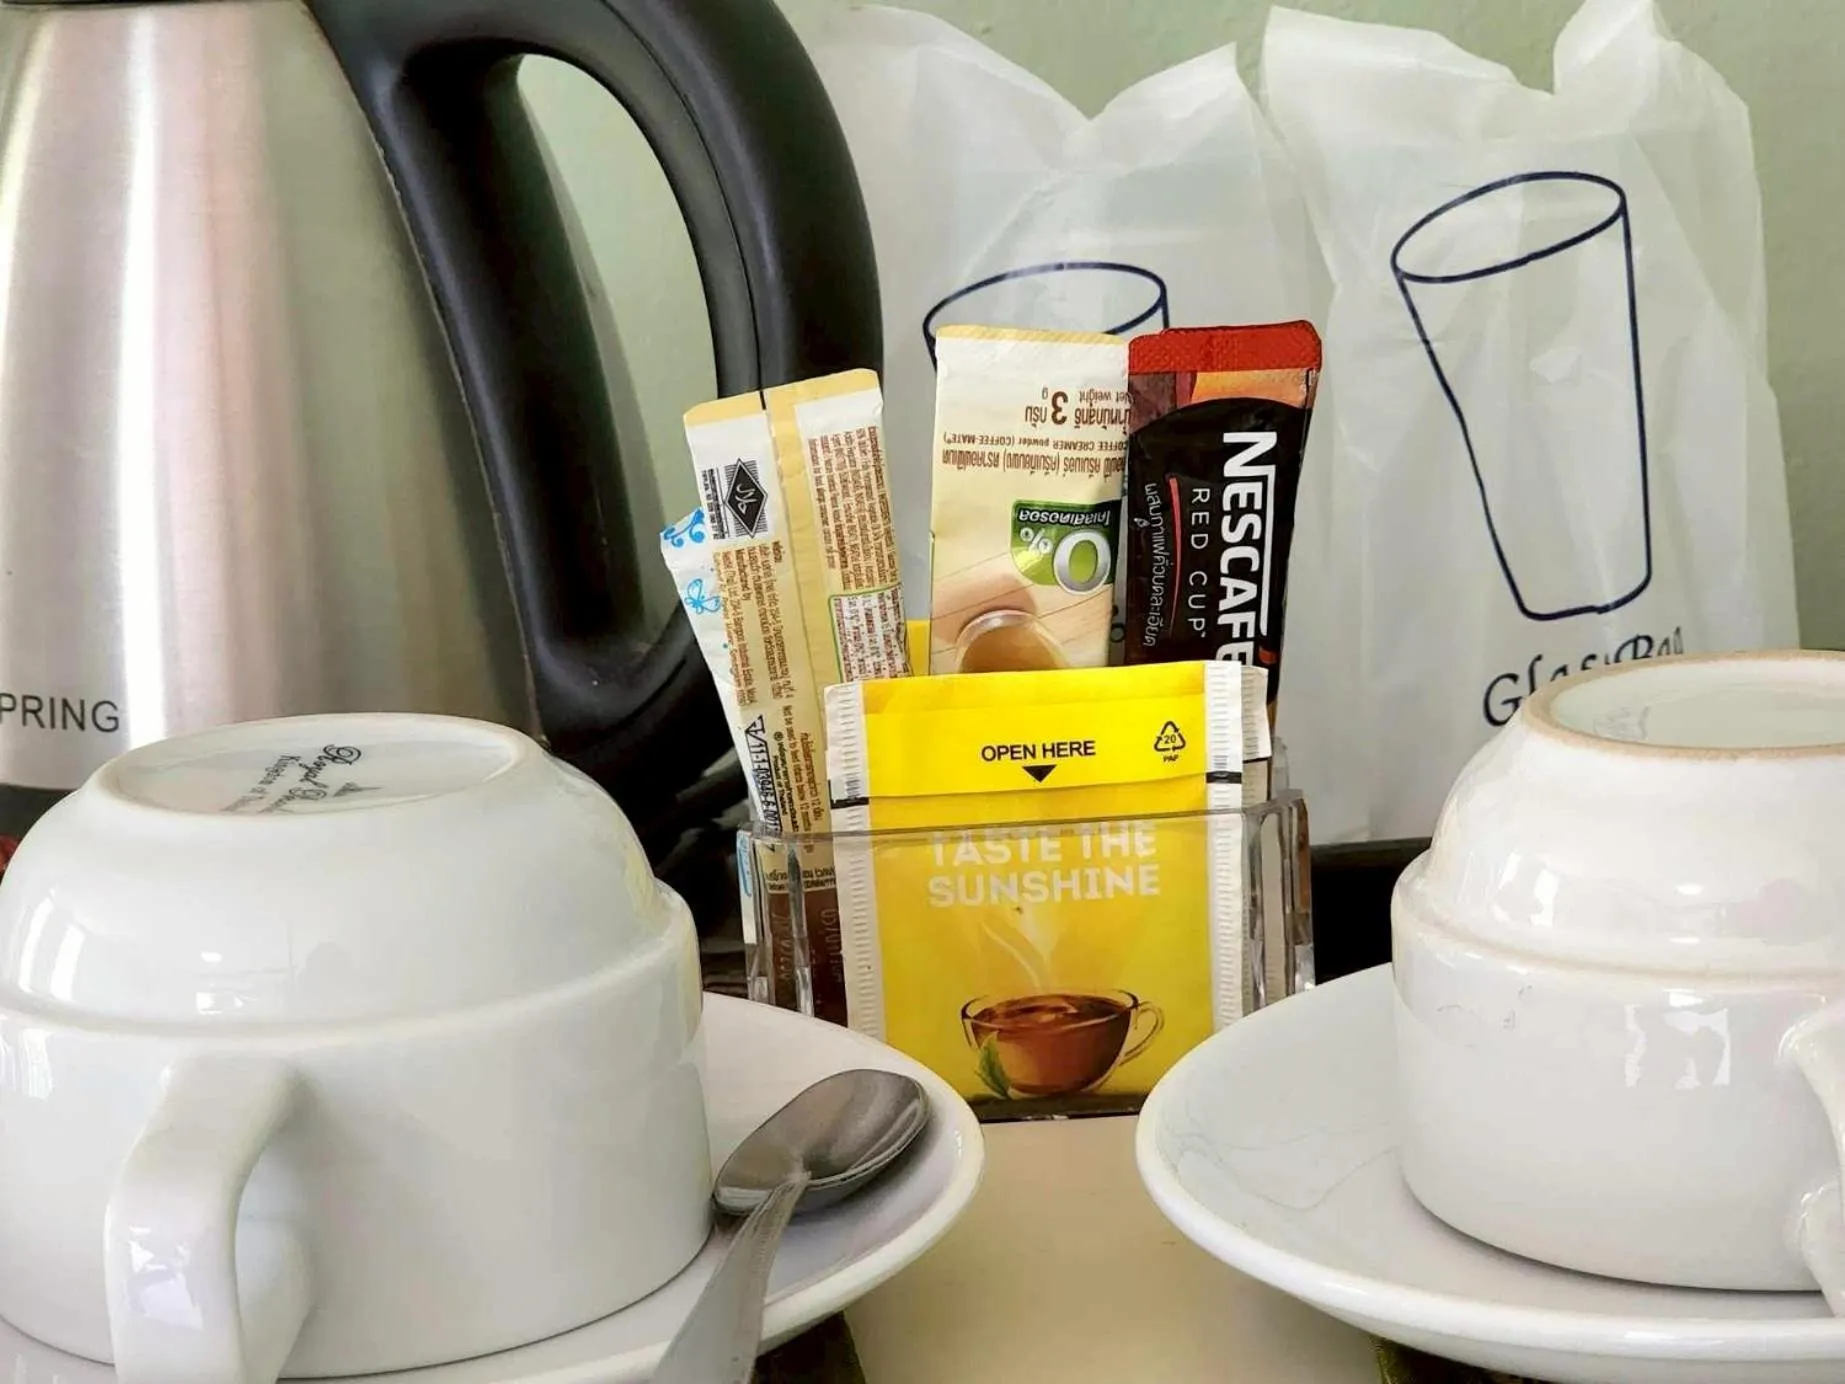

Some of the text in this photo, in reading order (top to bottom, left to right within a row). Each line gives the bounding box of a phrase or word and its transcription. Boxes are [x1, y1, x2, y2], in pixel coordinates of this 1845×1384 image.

[1079, 388, 1112, 404] weight
[1051, 391, 1069, 425] 3
[1018, 436, 1050, 448] powder
[1052, 439, 1096, 451] CREAMER
[1190, 487, 1211, 550] RED
[1163, 733, 1177, 745] 20
[981, 740, 1096, 762] OPEN HERE
[932, 819, 1157, 867] TASTE THE
[928, 862, 1160, 908] SUNSHINE
